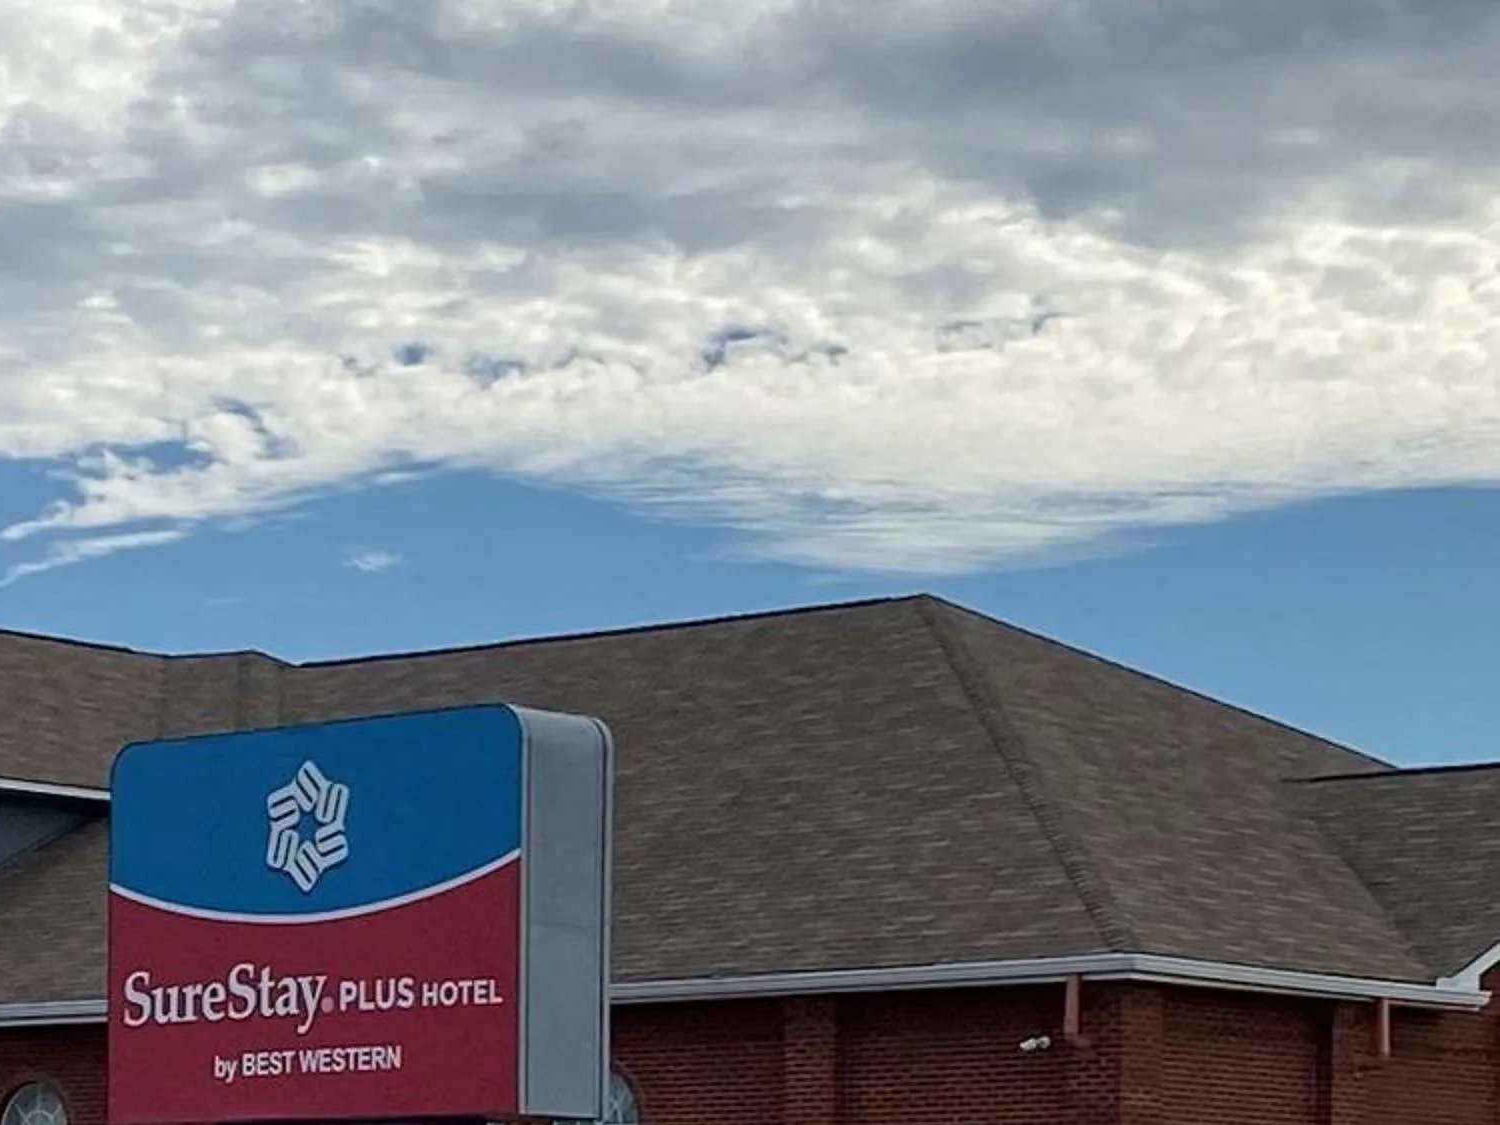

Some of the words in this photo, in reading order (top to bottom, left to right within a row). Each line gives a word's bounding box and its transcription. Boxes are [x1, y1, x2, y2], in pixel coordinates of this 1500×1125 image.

[123, 962, 328, 1034] SureStay
[339, 978, 414, 1010] PLUS
[421, 979, 503, 1008] HOTEL
[214, 1055, 238, 1082] by
[242, 1051, 296, 1077] BEST
[299, 1046, 402, 1072] WESTERN
